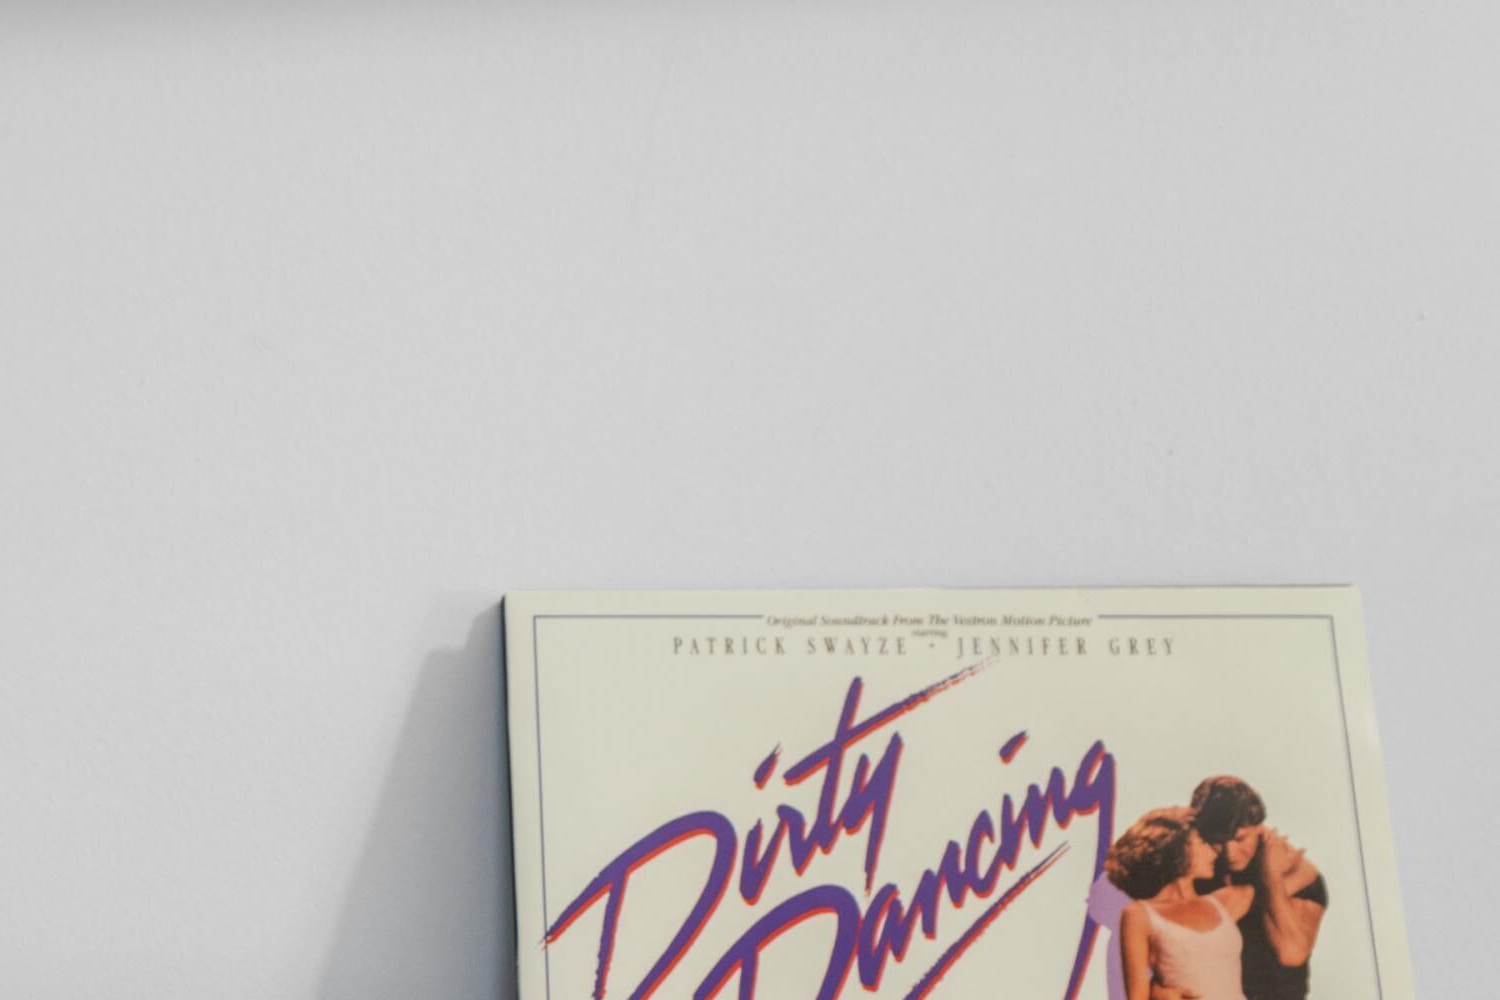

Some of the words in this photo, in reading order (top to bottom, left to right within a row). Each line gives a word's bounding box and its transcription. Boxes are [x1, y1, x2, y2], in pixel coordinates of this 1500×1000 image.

[766, 615, 818, 628] Original
[819, 615, 889, 626] Soundtrack
[892, 615, 925, 627] From
[928, 615, 950, 626] The
[1001, 615, 1046, 627] Motion
[1049, 616, 1094, 628] Picture
[672, 636, 787, 656] PATRICK
[807, 636, 908, 656] SWAYZE
[955, 636, 1088, 660] JENNIFER
[1108, 636, 1175, 656] GREY
